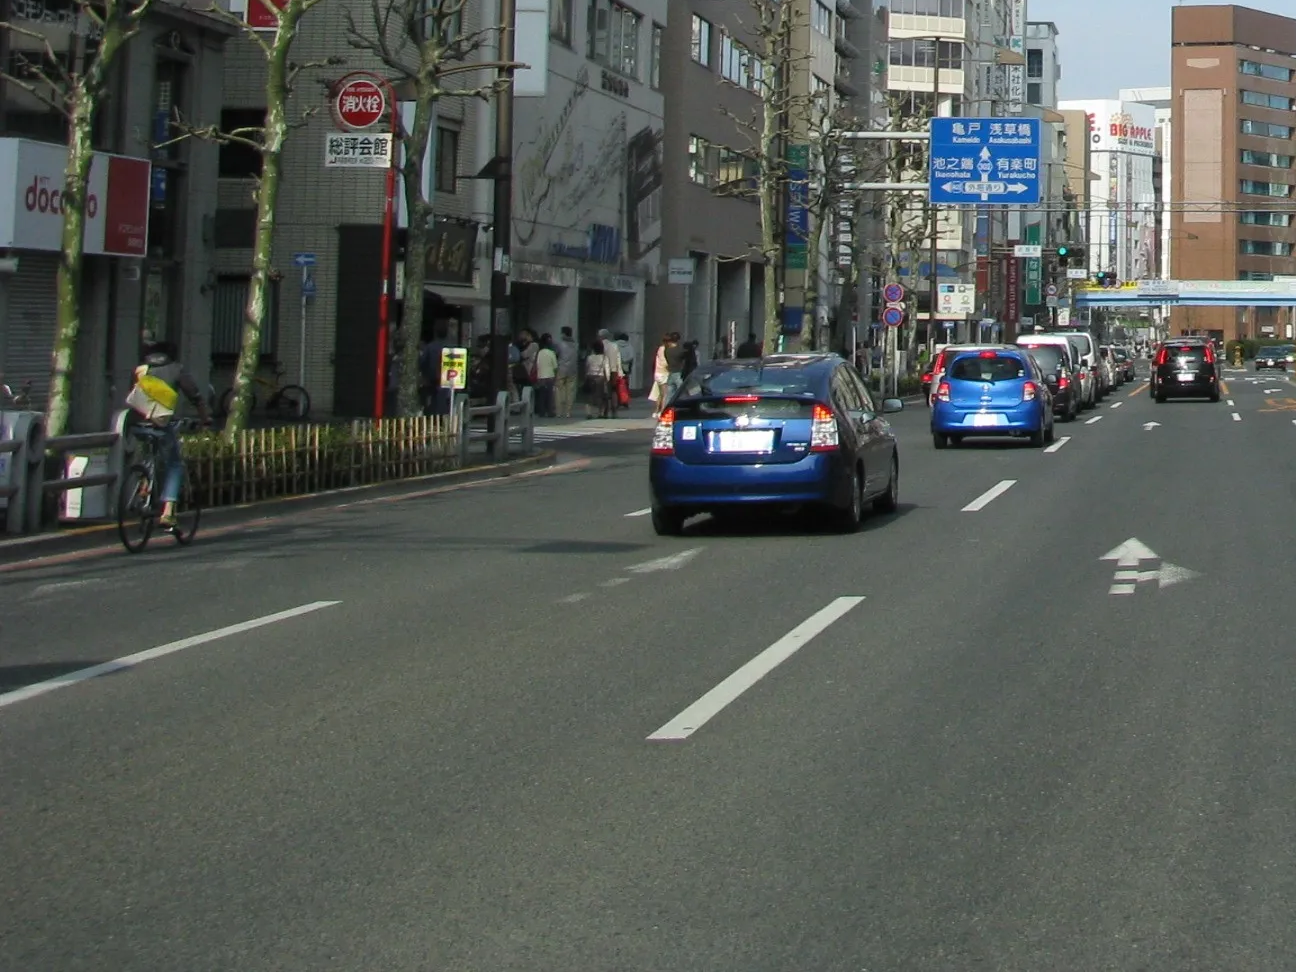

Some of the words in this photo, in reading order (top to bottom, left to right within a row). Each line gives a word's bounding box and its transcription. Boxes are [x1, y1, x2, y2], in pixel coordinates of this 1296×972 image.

[342, 95, 380, 113] 消火栓
[952, 122, 980, 136] 亀戸
[989, 122, 1031, 136] 浅草橋
[1110, 123, 1128, 137] BIG
[328, 137, 388, 156] 総評会館
[933, 157, 974, 170] 池之端
[996, 158, 1037, 171] 有楽町
[25, 175, 97, 218] doco
